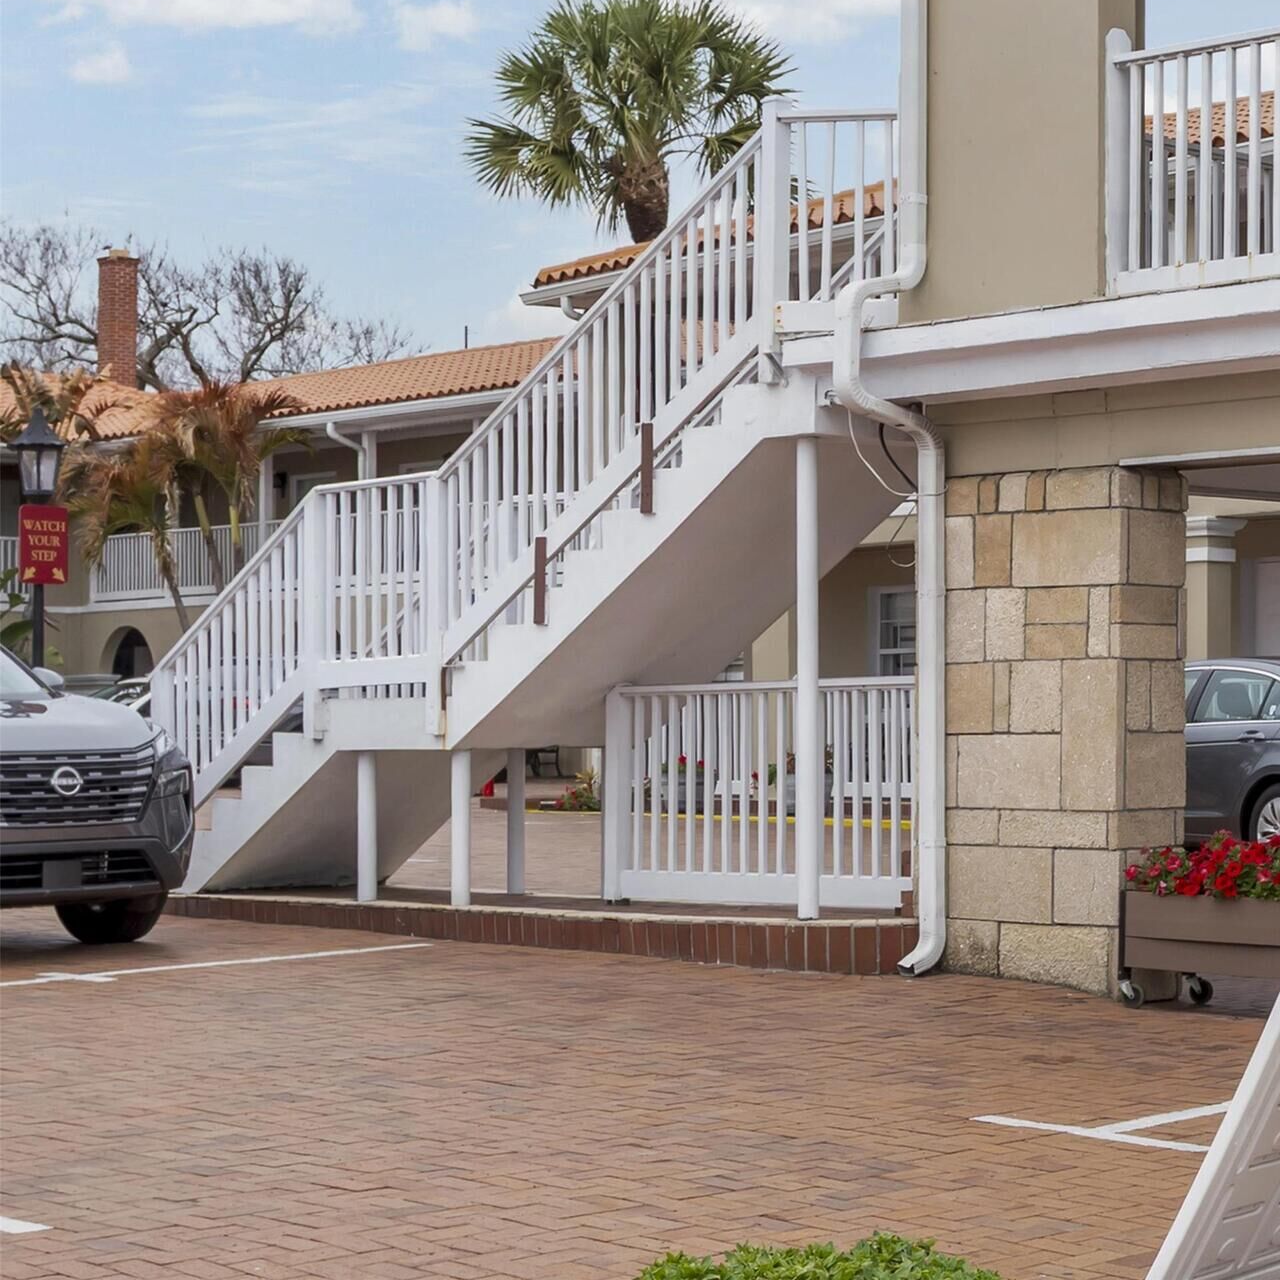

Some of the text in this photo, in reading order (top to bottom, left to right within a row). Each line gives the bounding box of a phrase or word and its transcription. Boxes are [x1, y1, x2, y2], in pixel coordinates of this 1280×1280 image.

[23, 519, 65, 532] WATCH
[28, 534, 61, 547] YOUR
[31, 549, 57, 562] STEP
